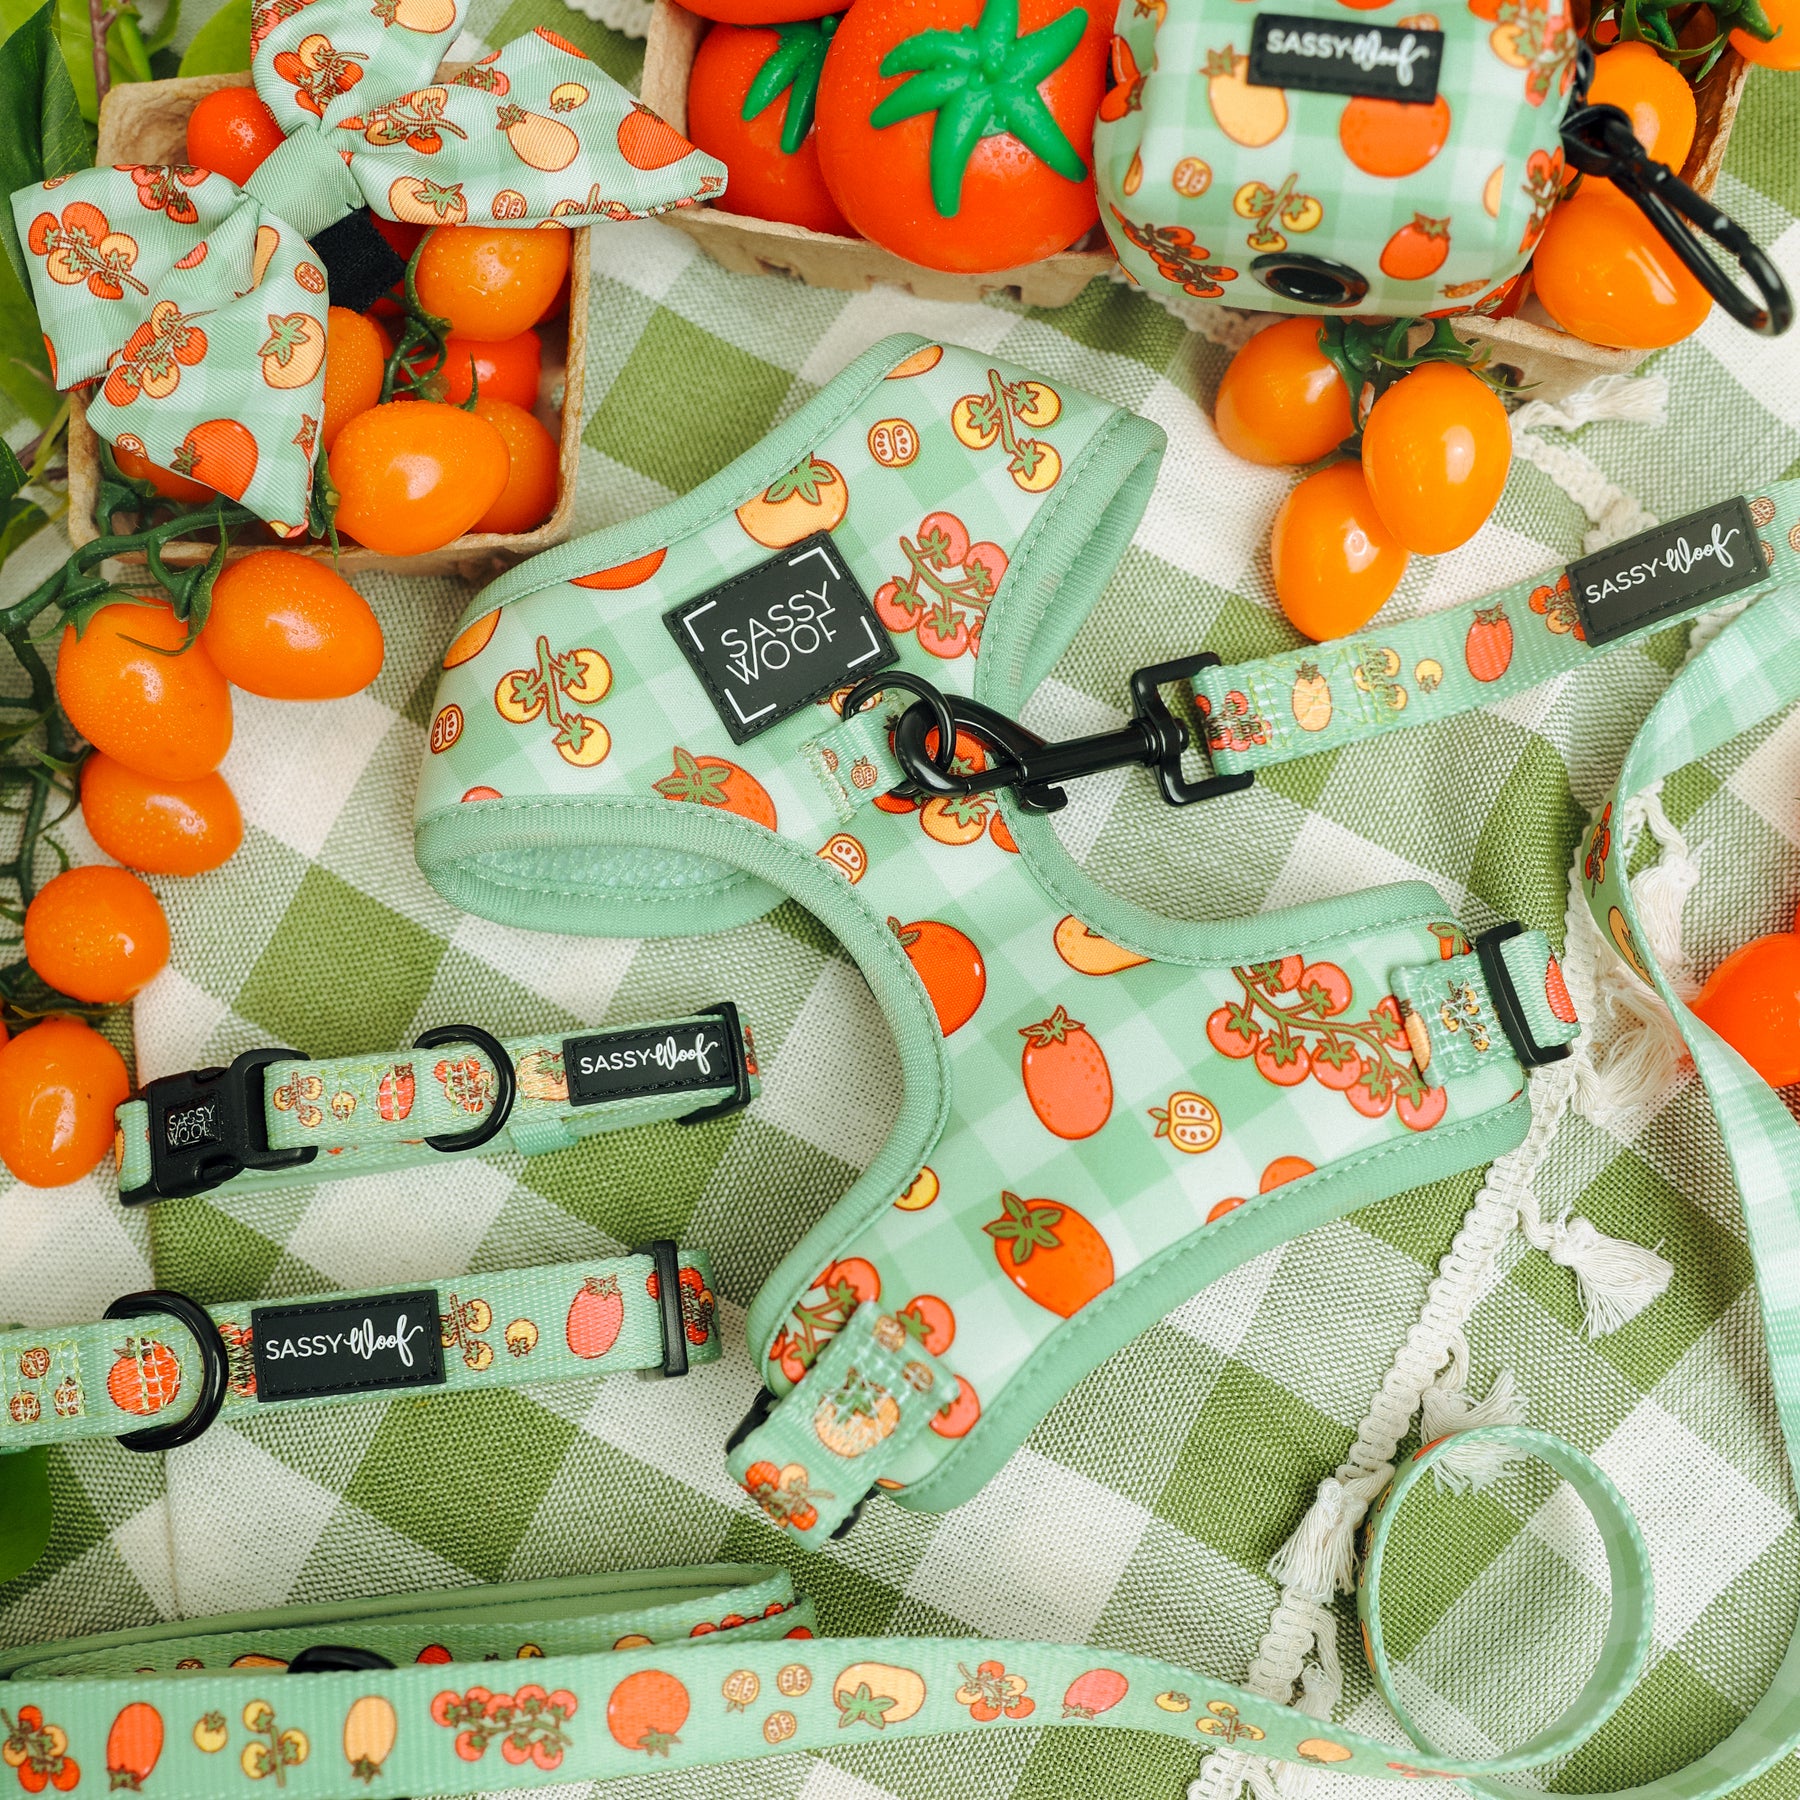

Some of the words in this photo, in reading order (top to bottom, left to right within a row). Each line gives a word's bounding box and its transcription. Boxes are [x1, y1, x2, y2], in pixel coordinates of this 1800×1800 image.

[1266, 28, 1351, 60] SASSY
[1585, 557, 1659, 604] SASSY
[1659, 523, 1741, 574] Woof
[720, 580, 831, 659] SASSY
[725, 607, 838, 686] WOOF
[580, 1048, 651, 1075] SASSY
[650, 1032, 719, 1075] Woof
[168, 1104, 216, 1131] SASSY
[265, 1333, 344, 1360] SASSY
[343, 1313, 424, 1368] Woof
